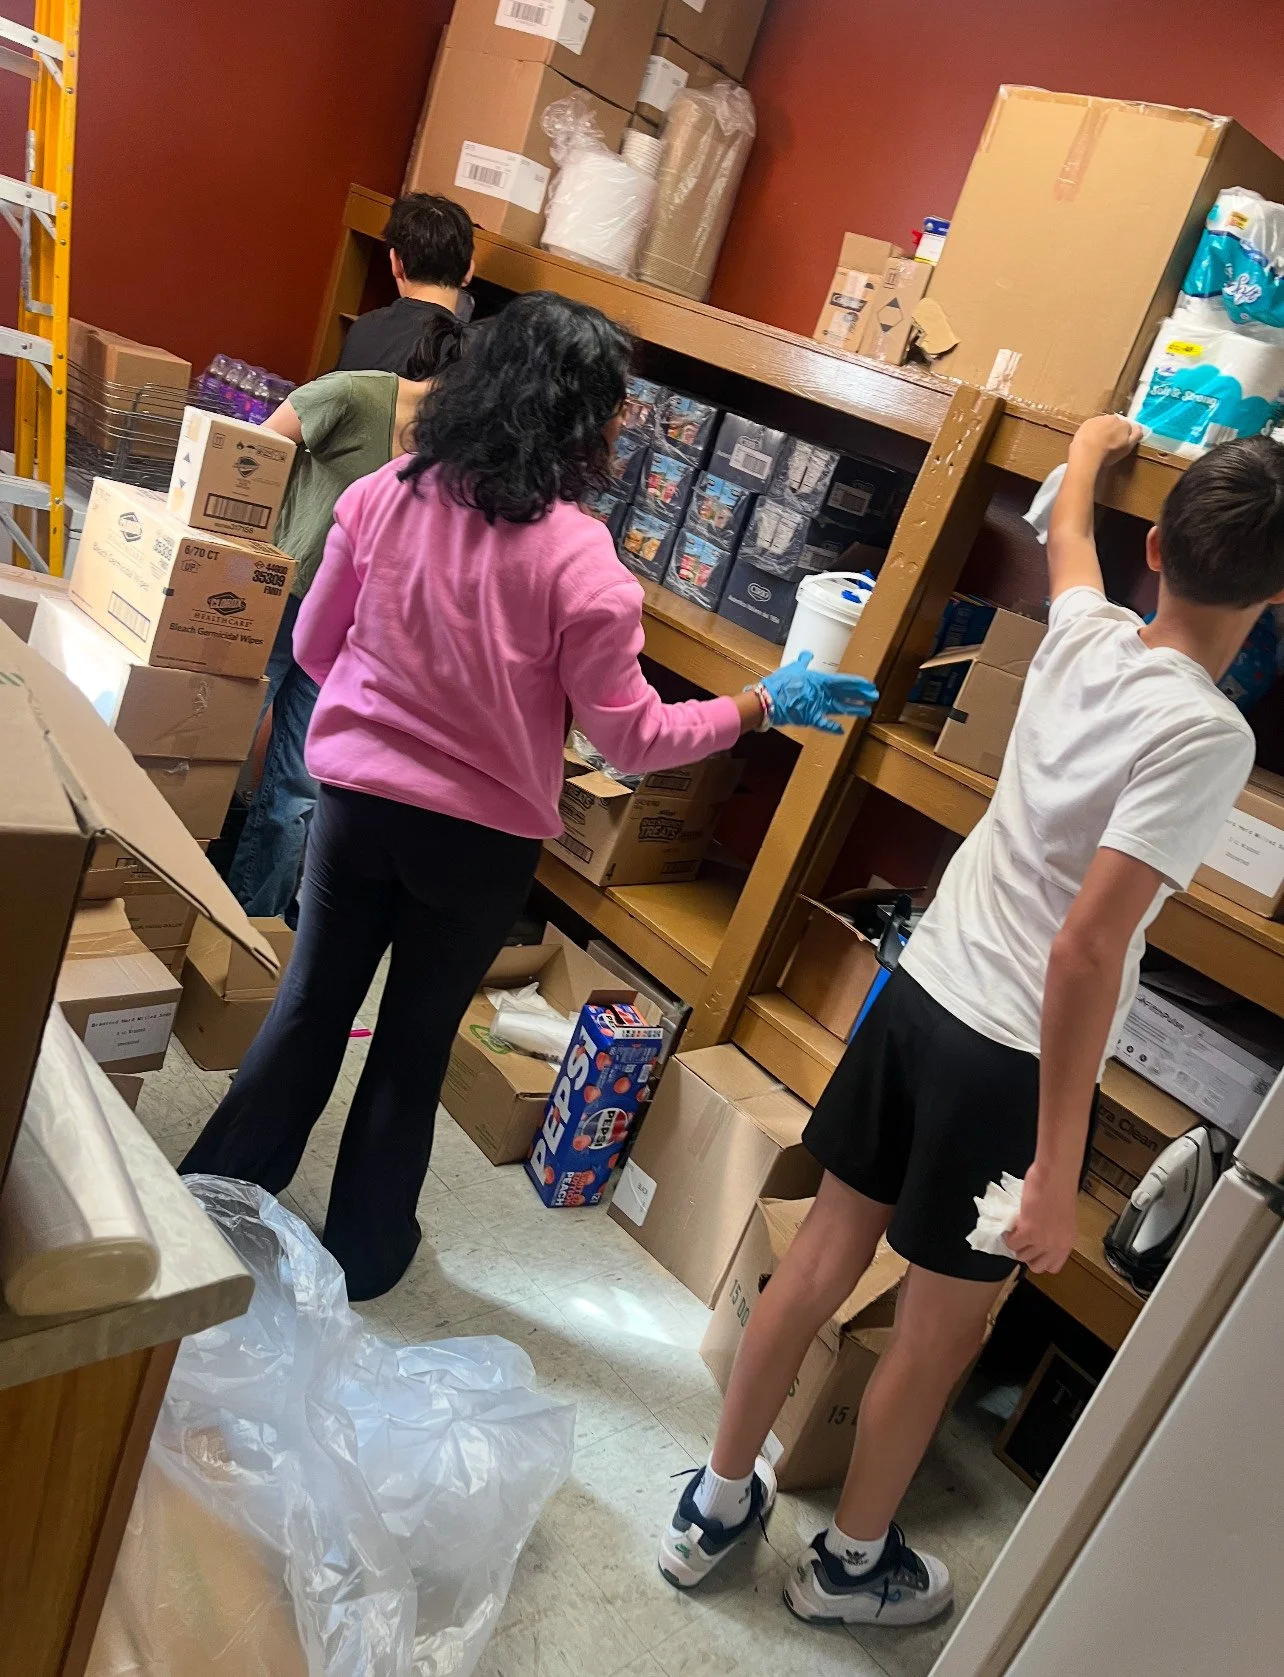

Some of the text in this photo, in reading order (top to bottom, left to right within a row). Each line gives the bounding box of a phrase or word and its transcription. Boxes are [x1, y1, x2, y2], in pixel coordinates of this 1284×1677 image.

[184, 545, 220, 561] 6/70 CT
[252, 570, 286, 587] 35309
[169, 622, 264, 646] Bleach Germicidal Wipes
[530, 1025, 598, 1186] PEPSI
[594, 1110, 616, 1147] PEPSI
[1118, 1114, 1158, 1151] Clean
[555, 1171, 575, 1207] PEACH
[729, 1279, 741, 1305] 15
[827, 1406, 850, 1425] 15
